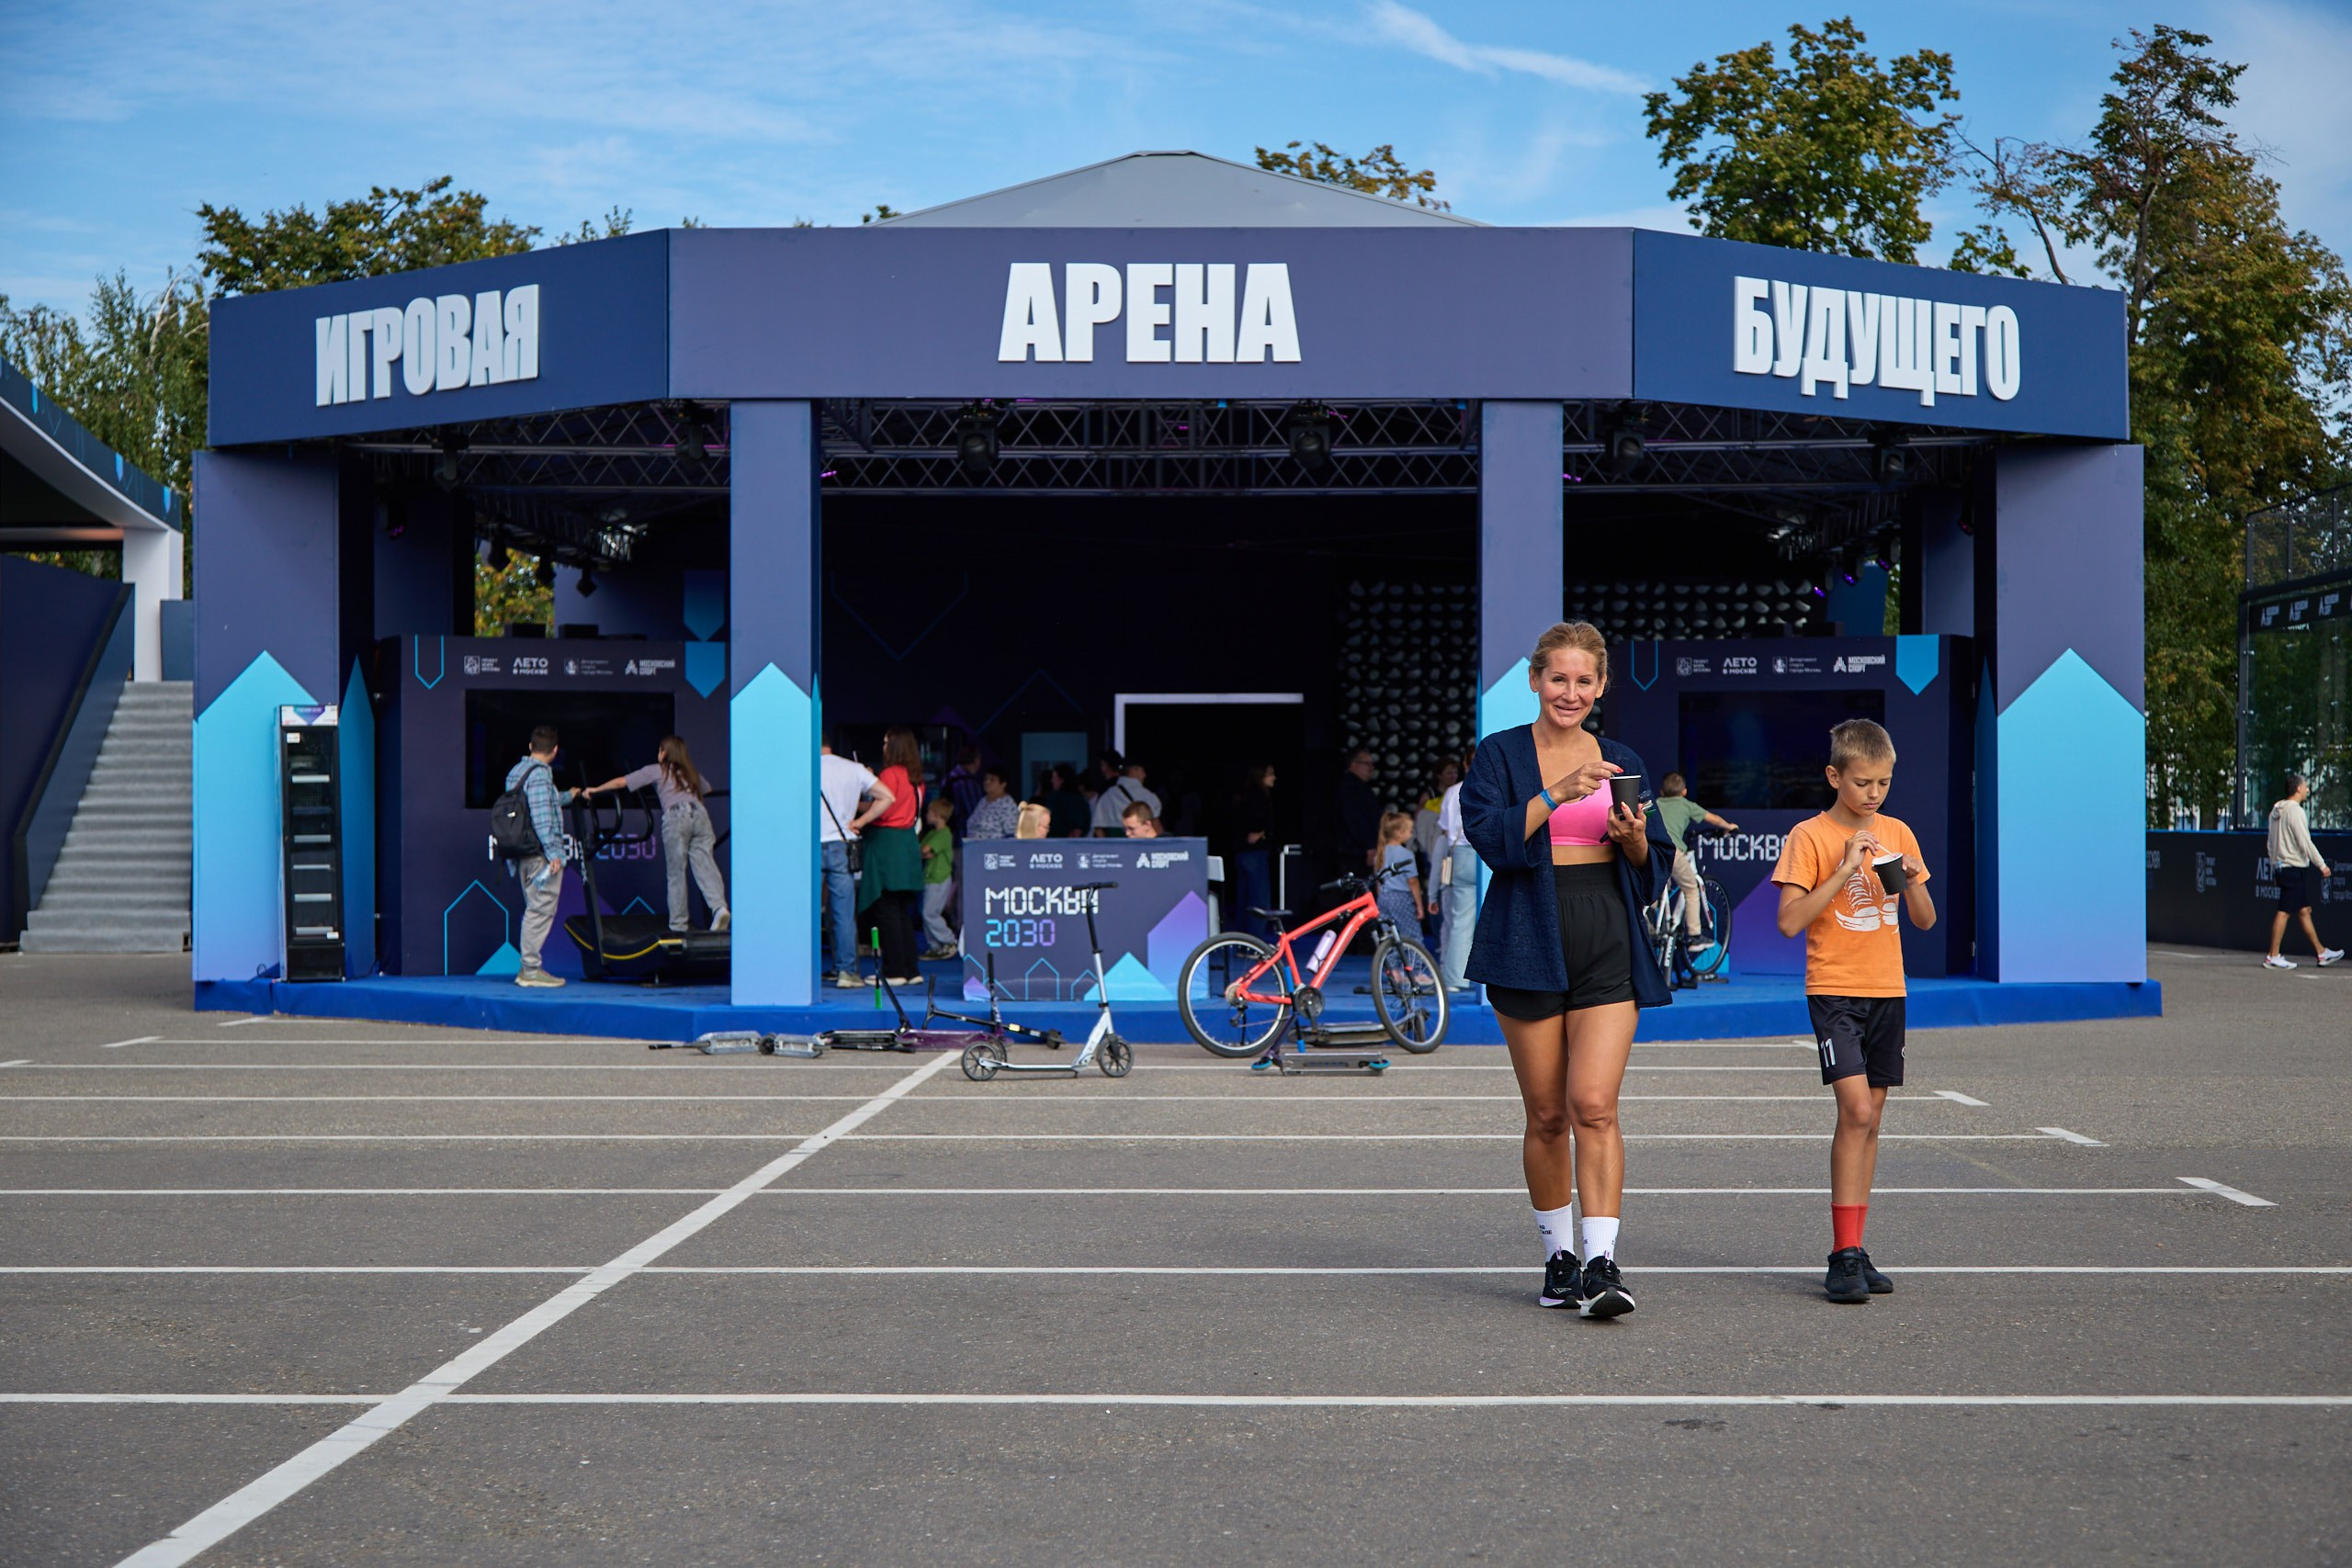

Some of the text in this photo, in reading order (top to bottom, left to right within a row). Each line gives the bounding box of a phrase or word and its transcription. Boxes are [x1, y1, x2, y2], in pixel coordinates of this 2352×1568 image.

[316, 263, 2020, 406] ИГРОВАЯ АРЕНА БУДУЩЕГО
[513, 657, 548, 668] ЛЕТО
[1723, 657, 1758, 668] ЛЕТО
[1848, 654, 1885, 665] МОСКОВСКИЙ
[1698, 834, 1789, 861] МОСКВ
[1029, 853, 1064, 863] ЛЕТО
[985, 919, 1056, 947] 2030
[1820, 1037, 1837, 1068] 11
